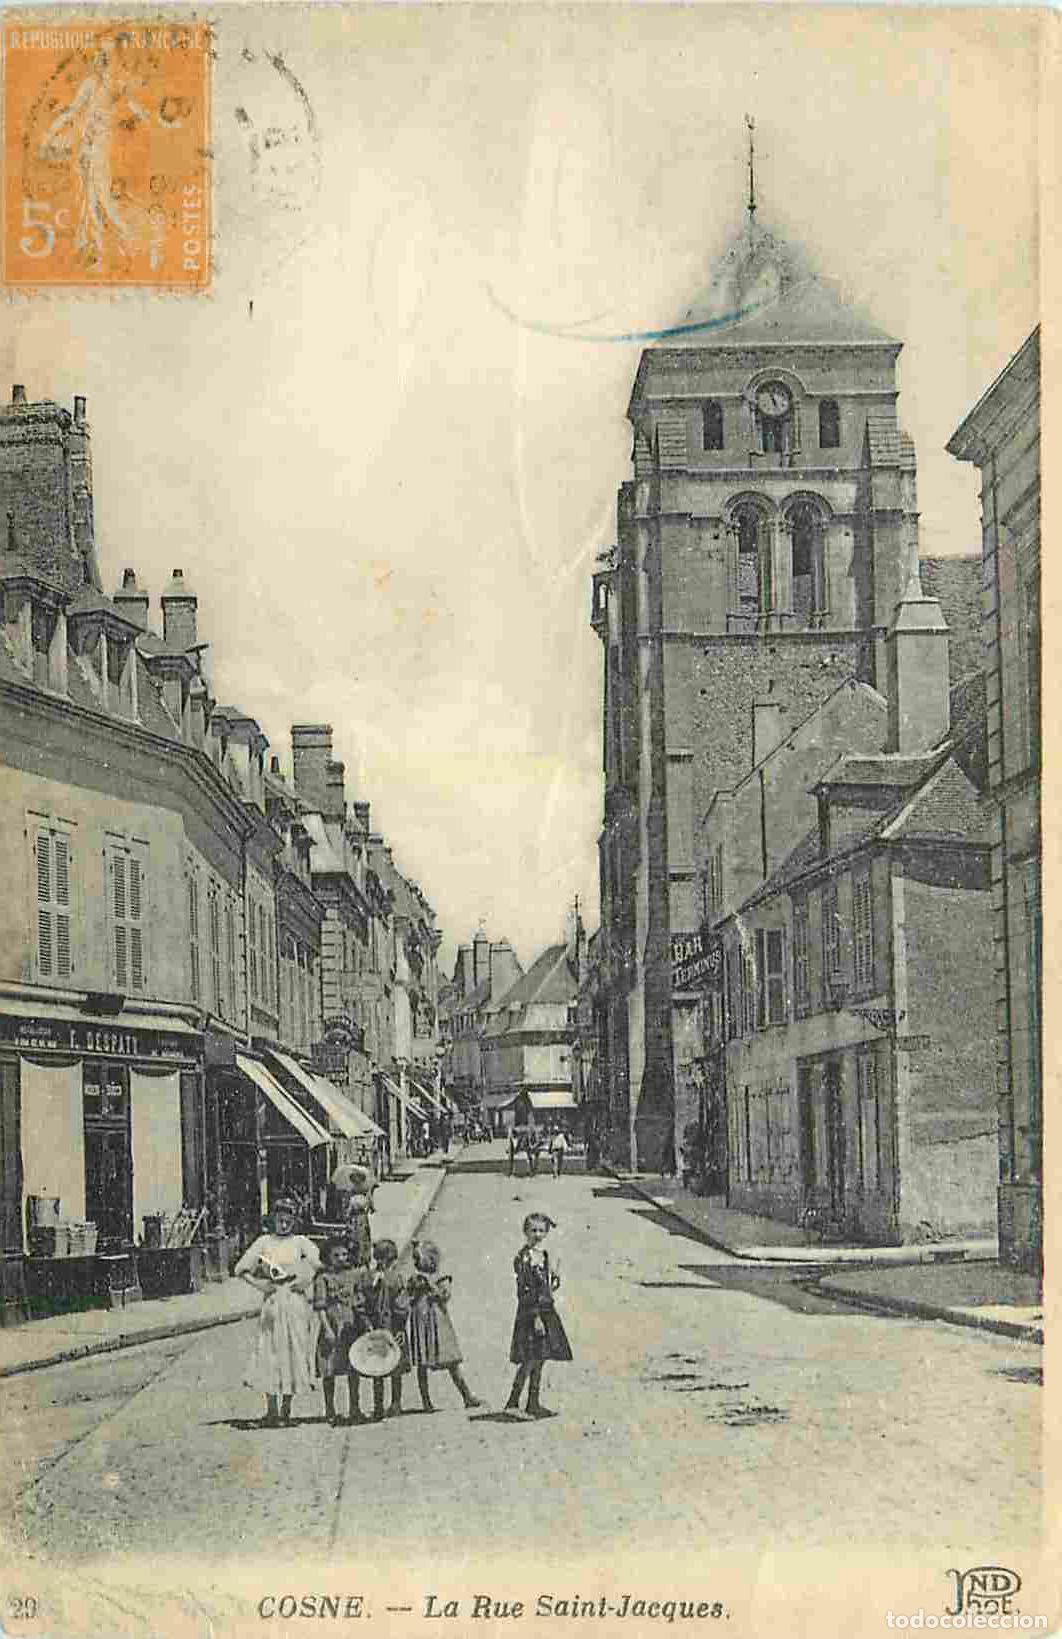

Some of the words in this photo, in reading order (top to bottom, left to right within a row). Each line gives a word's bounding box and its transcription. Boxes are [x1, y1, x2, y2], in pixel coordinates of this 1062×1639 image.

[181, 183, 202, 270] POSTES
[256, 1594, 372, 1619] COSNE.
[422, 1594, 461, 1619] La
[470, 1594, 525, 1619] Rue
[535, 1593, 731, 1623] Saint-Jacques.
